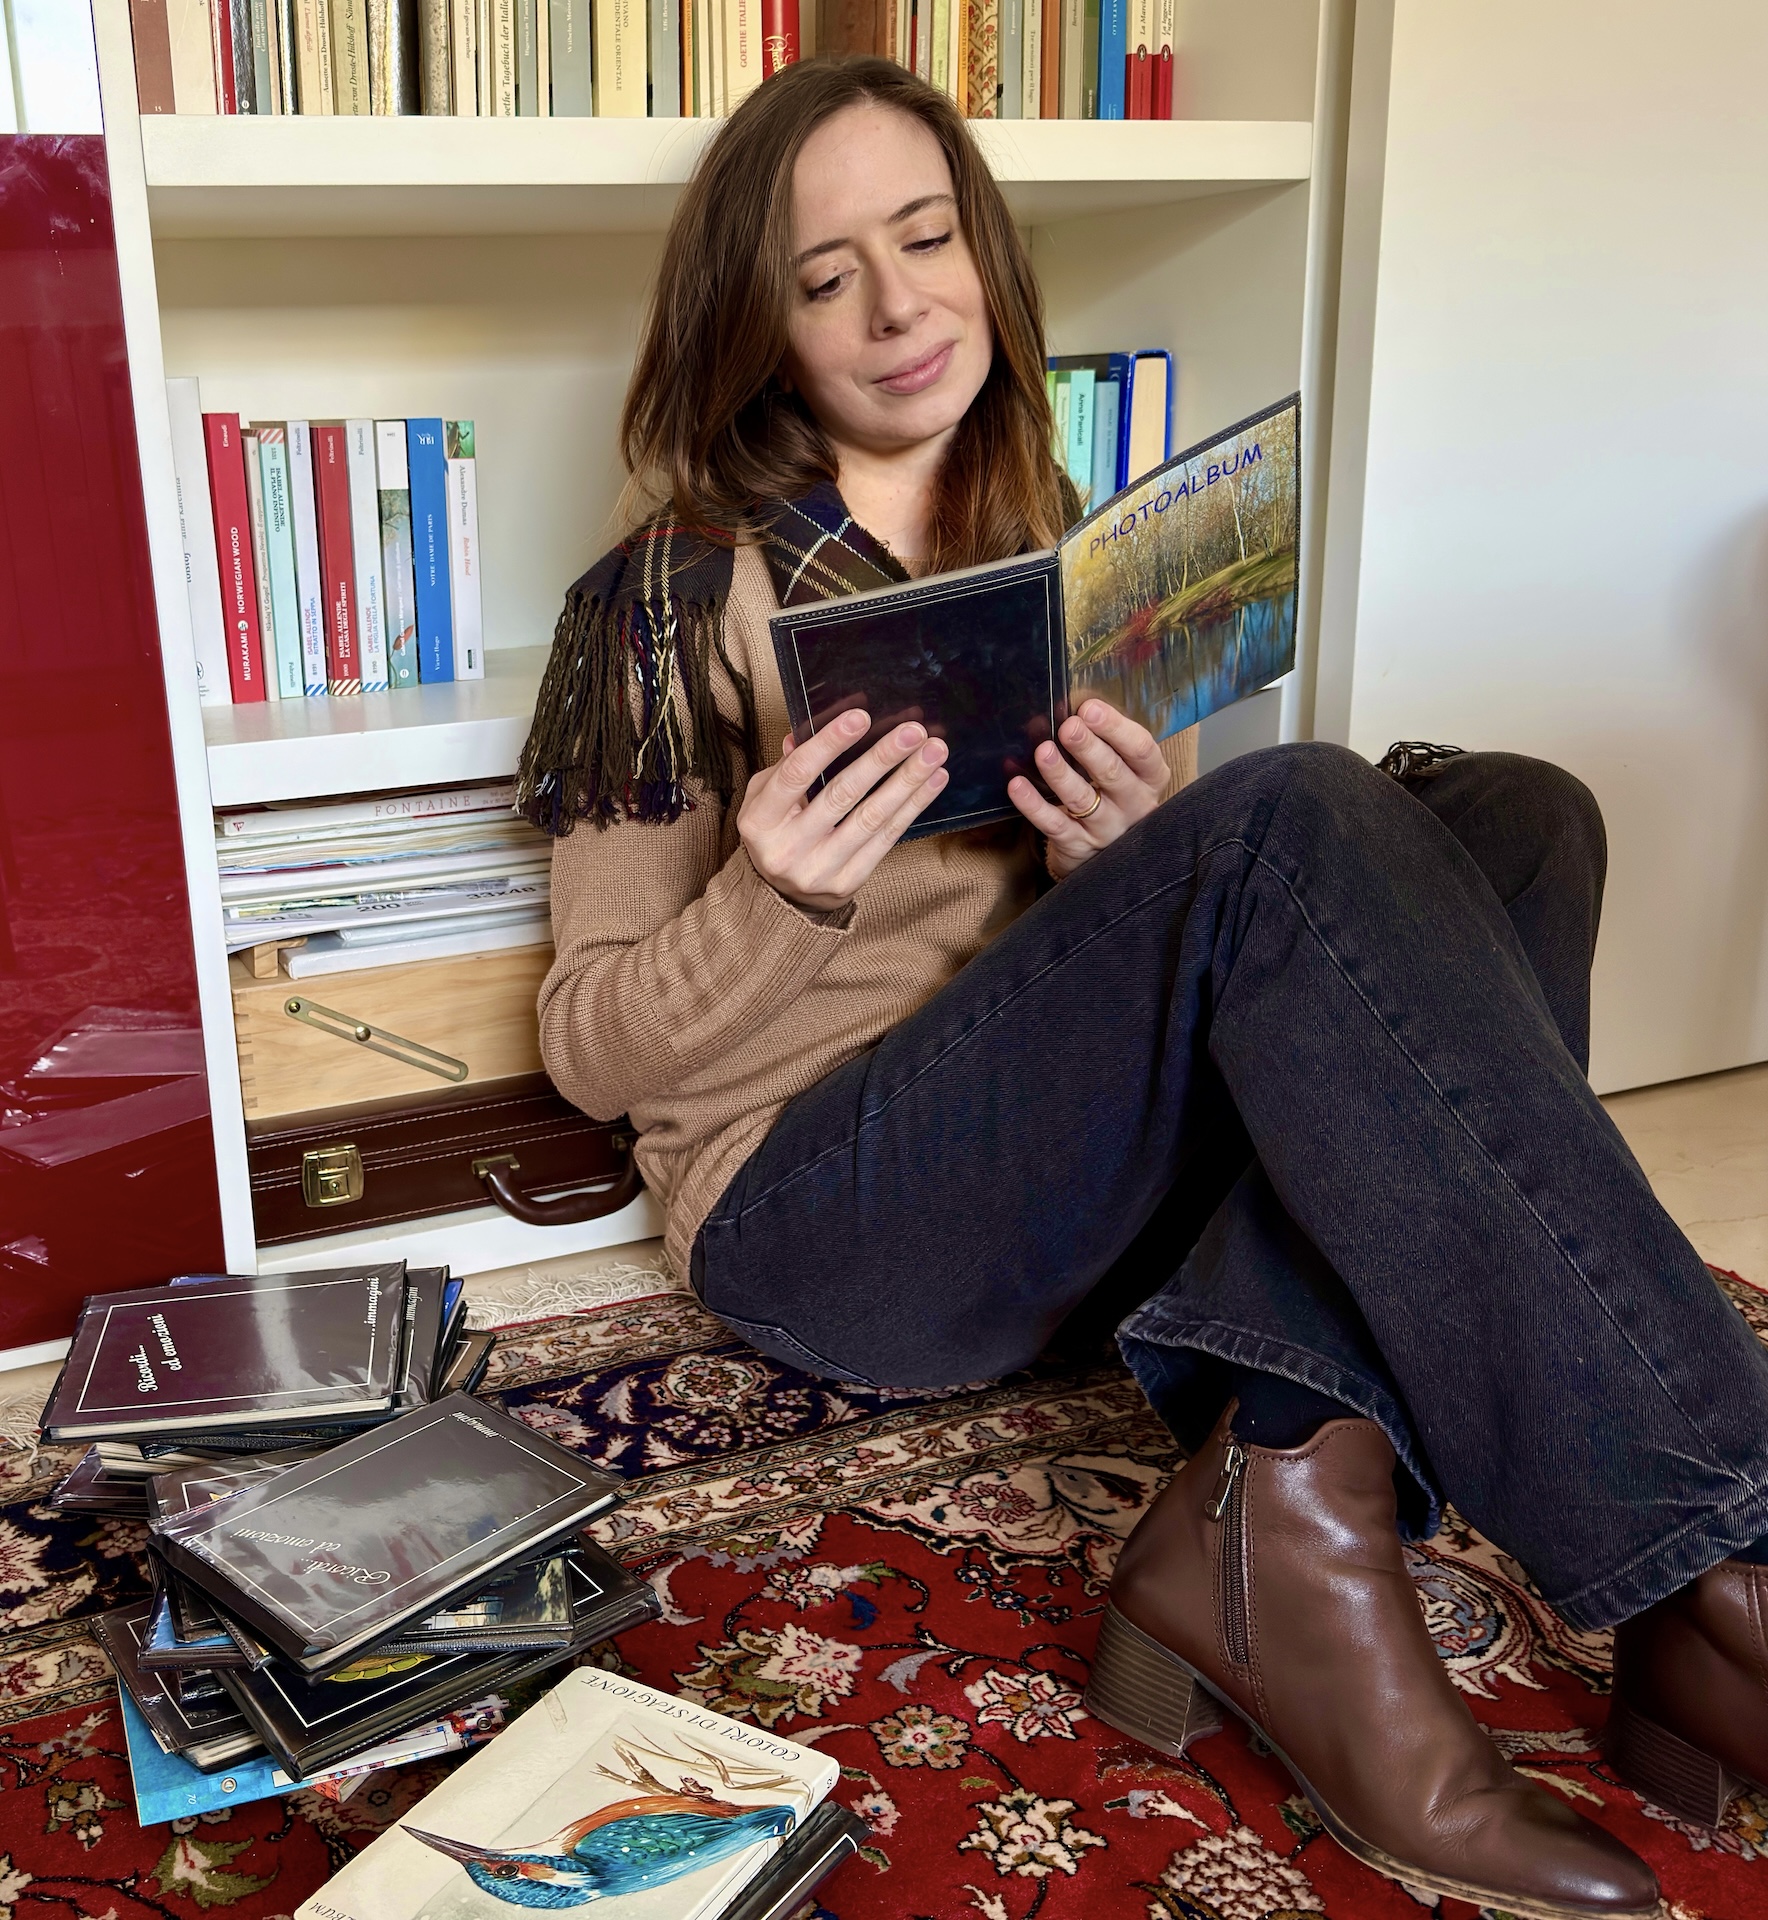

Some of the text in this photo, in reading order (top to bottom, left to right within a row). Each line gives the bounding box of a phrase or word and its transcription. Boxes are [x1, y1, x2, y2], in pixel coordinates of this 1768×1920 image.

[500, 25, 509, 41] der
[1140, 25, 1146, 35] La
[739, 30, 747, 68] GOETHE
[501, 44, 512, 87] Tagebuch
[502, 91, 511, 116] oethe
[221, 424, 229, 447] Einaudi
[270, 467, 275, 475] IL
[1089, 443, 1263, 558] PHOTOALBUM
[272, 499, 280, 532] INFINITO
[428, 533, 433, 543] DE
[230, 526, 251, 681] MURAKAMI NORWEGIAN WOOD
[304, 608, 312, 634] ALLENDE
[337, 635, 345, 658] ISABEL
[344, 647, 350, 658] LA
[373, 644, 379, 653] LA
[375, 795, 471, 817] FONTAINE
[356, 902, 400, 913] 200
[146, 1313, 183, 1371] ed emozioni
[128, 1344, 158, 1393] Ricordi...
[229, 1527, 341, 1554] ed emozioni
[300, 1557, 391, 1585] Ricordi...
[580, 1674, 801, 1762] COLORI DI STAGIONE
